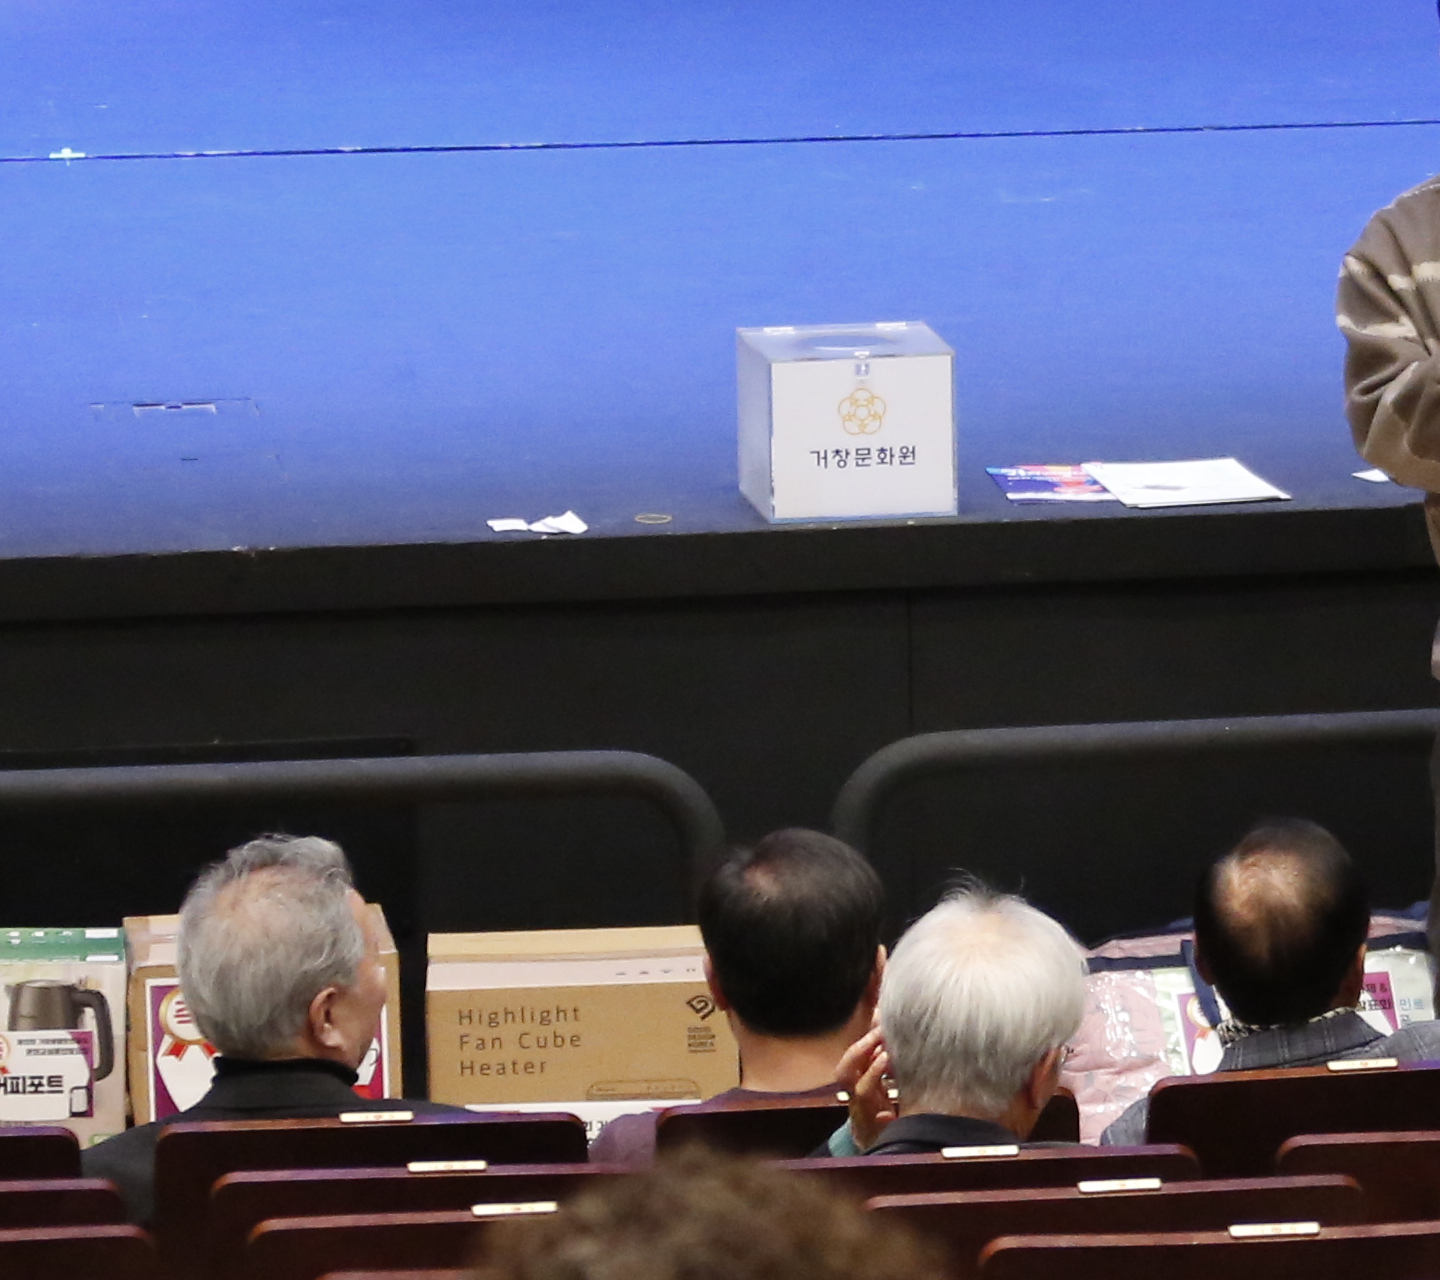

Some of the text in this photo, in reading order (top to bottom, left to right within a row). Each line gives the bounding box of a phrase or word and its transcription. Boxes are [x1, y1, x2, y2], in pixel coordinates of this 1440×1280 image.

[809, 445, 917, 468] 거창문화원
[458, 1005, 581, 1029] Highlight
[459, 1030, 583, 1052] Fan Cube
[460, 1059, 548, 1077] Heater
